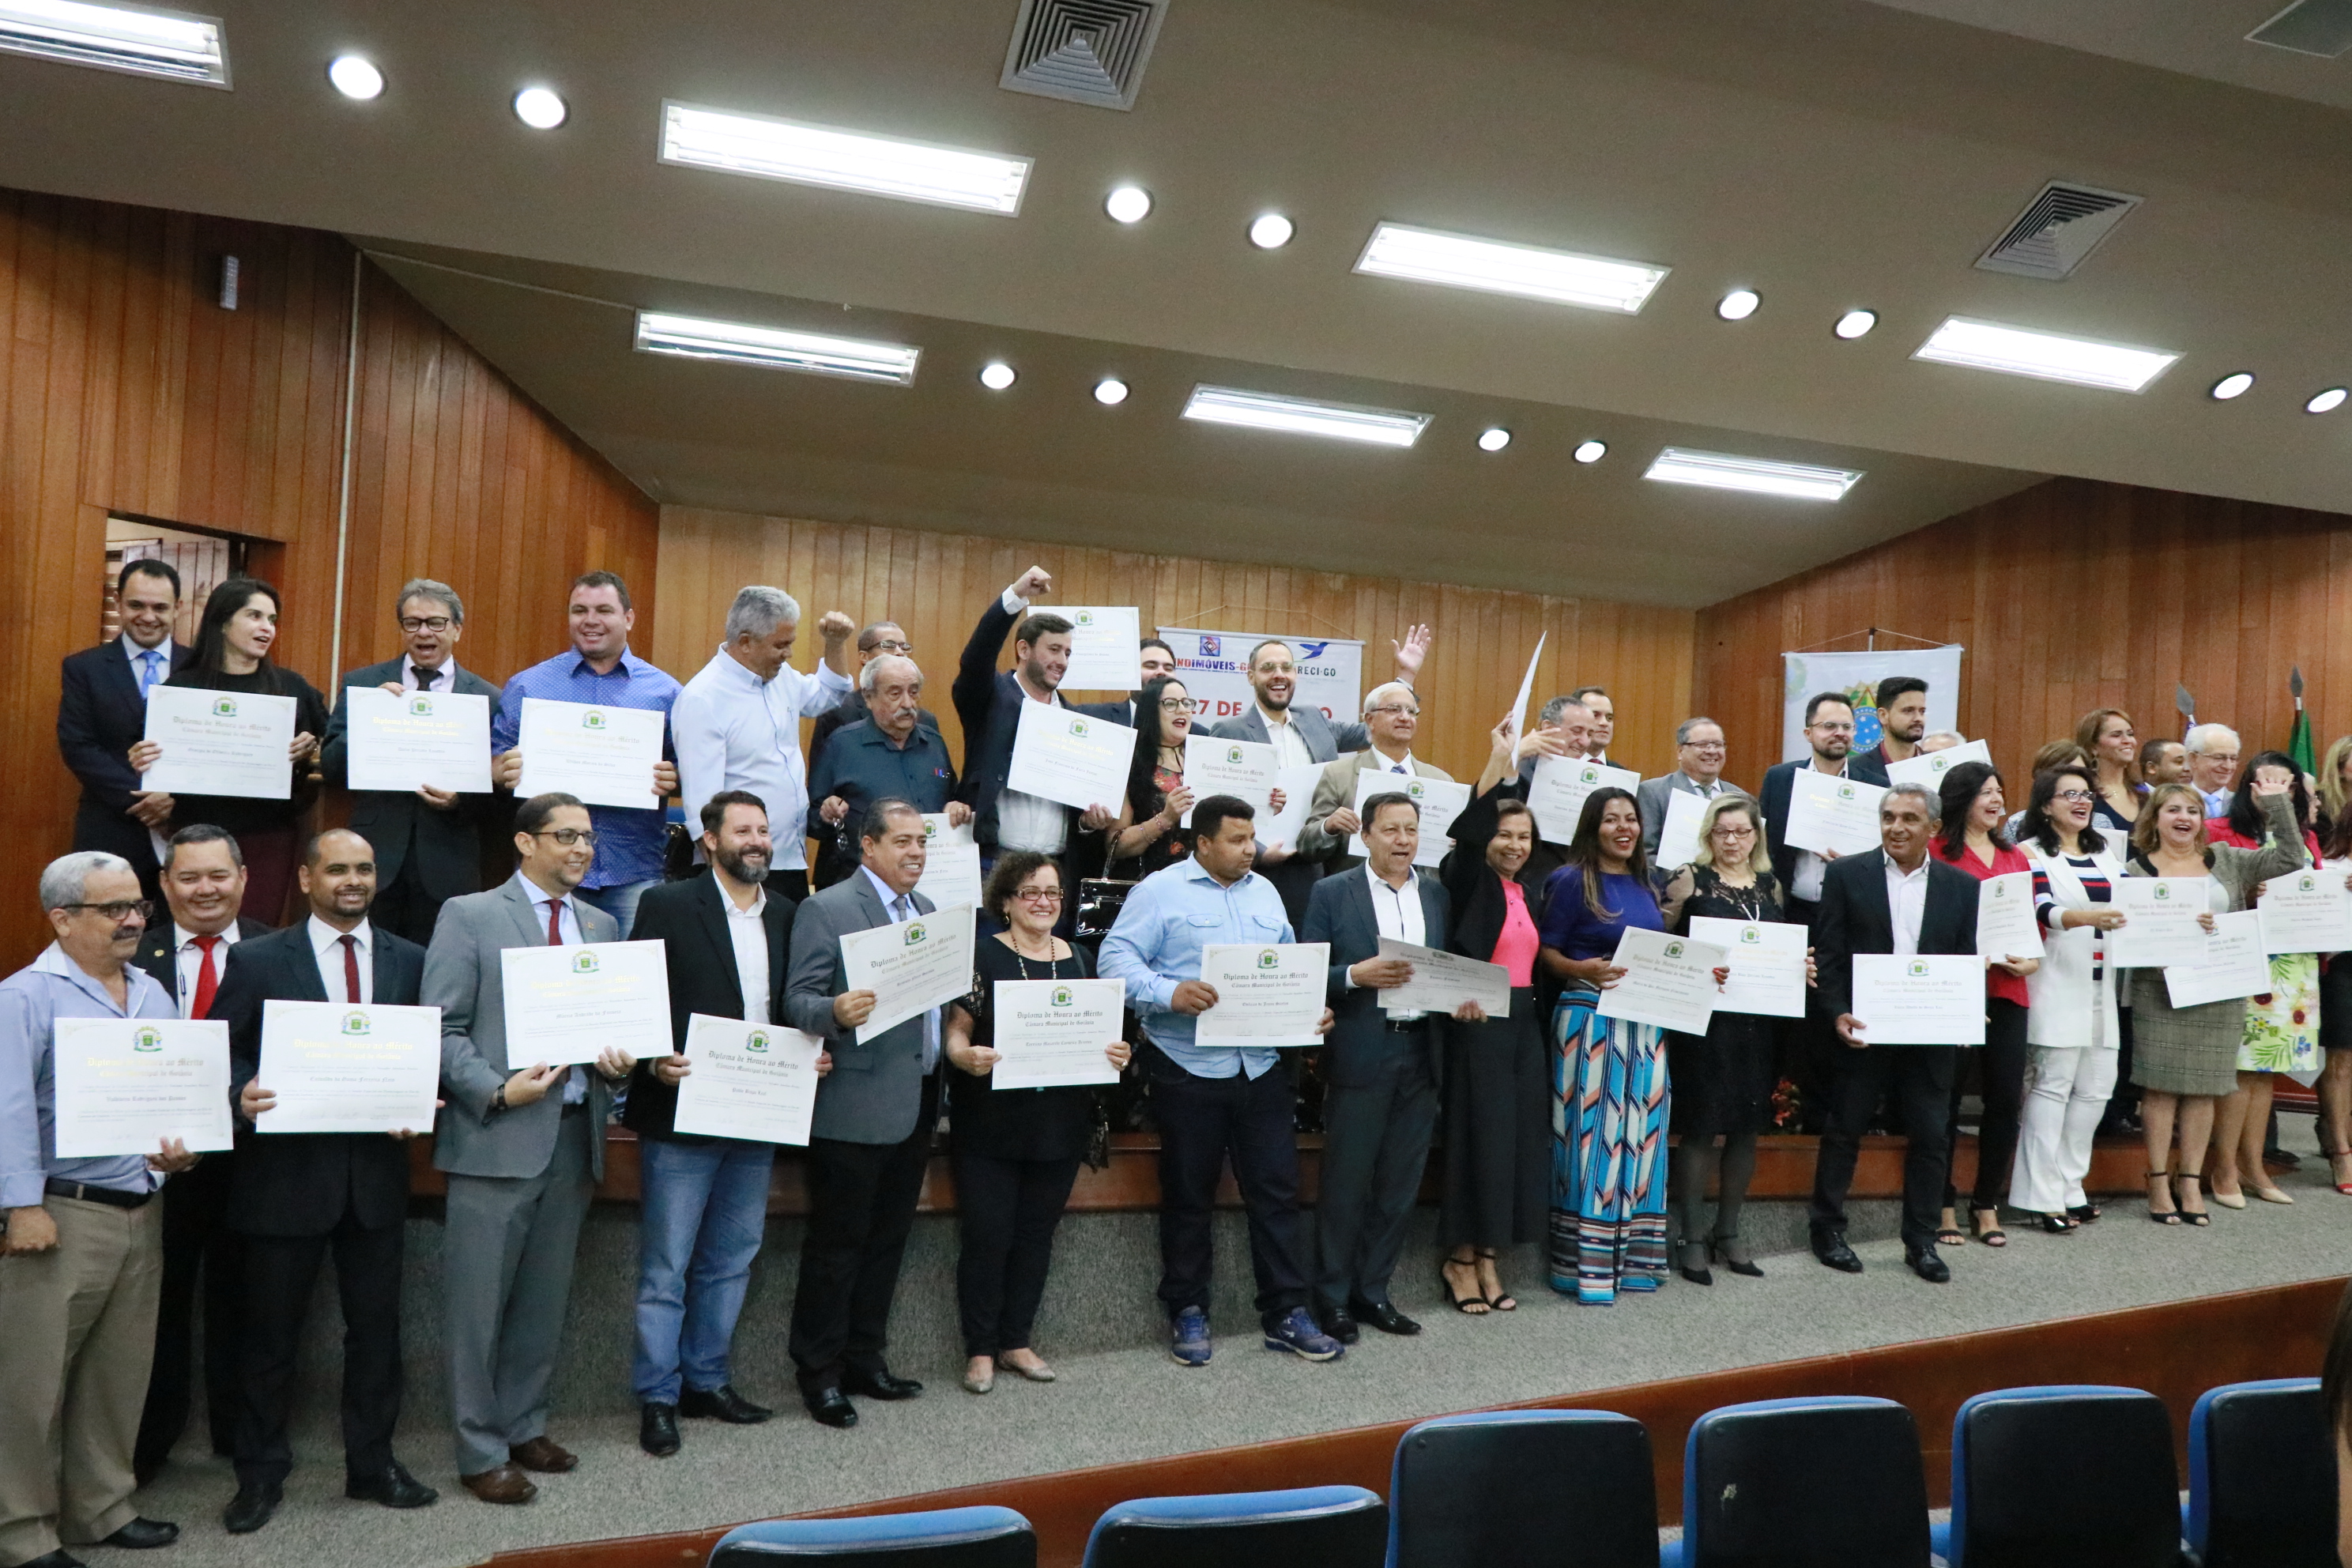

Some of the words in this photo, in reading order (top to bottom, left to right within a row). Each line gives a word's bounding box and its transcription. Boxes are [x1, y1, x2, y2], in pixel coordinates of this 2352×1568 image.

[1192, 699, 1210, 715] 7
[1217, 700, 1242, 716] DE
[173, 715, 202, 726] Diploma
[373, 716, 401, 725] Diploma
[1069, 738, 1086, 749] Honra
[1096, 745, 1114, 756] Mérito
[1551, 779, 1574, 789] Diploma
[870, 956, 898, 968] Diploma
[909, 945, 927, 956] Honra
[937, 934, 956, 946] Mérito
[882, 964, 900, 974] Câmara
[901, 956, 924, 966] Municipal
[1633, 954, 1654, 963] Diploma
[1687, 965, 1705, 974] Mérito
[530, 979, 563, 989] Diploma
[615, 975, 640, 984] Mérito
[1223, 973, 1250, 982] Diploma
[293, 1038, 330, 1049] Diploma
[345, 1040, 370, 1049] Honra
[386, 1042, 413, 1050] Mérito
[87, 1057, 120, 1067] Diploma
[178, 1057, 204, 1066] Mérito
[709, 1050, 735, 1061] Diploma
[747, 1055, 767, 1065] Honra
[778, 1061, 799, 1070] Mérito
[737, 1065, 761, 1074] Municipal
[769, 1069, 789, 1078] Goiânia
